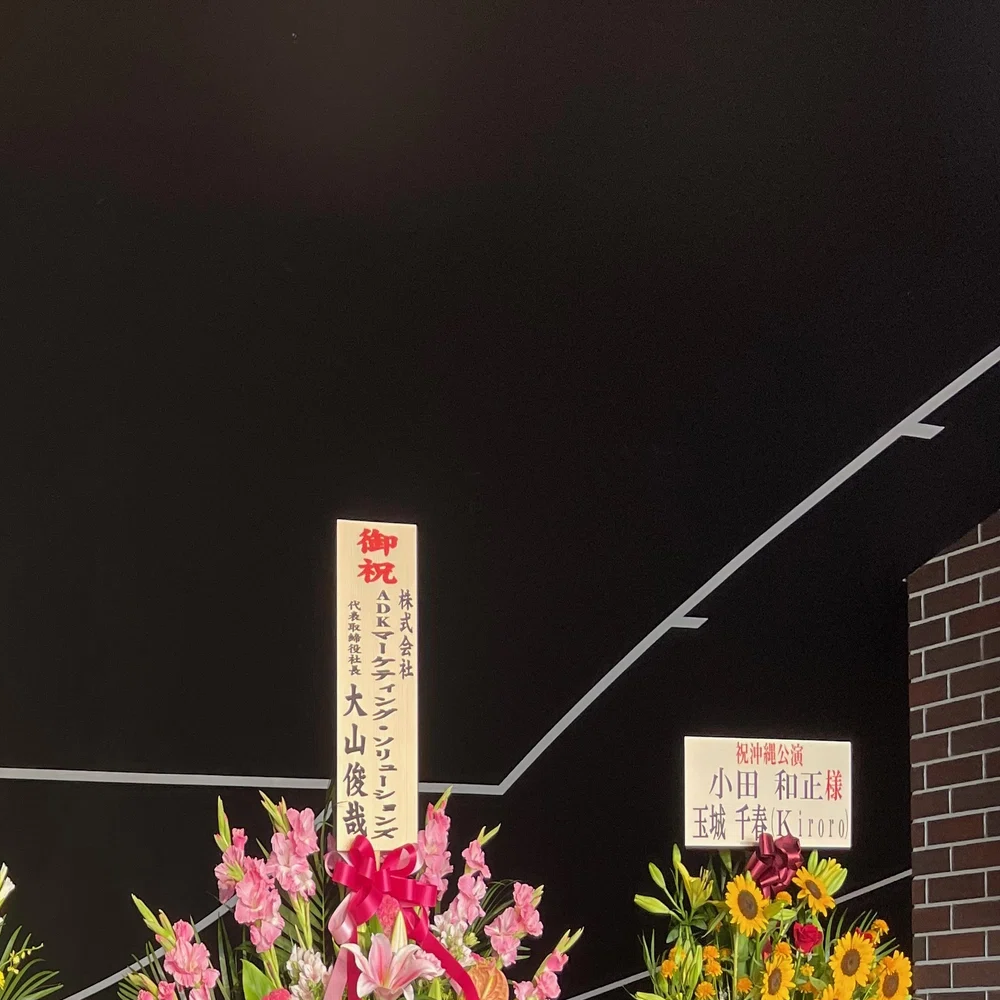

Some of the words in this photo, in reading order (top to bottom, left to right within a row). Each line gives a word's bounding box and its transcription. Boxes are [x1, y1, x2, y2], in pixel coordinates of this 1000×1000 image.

[356, 527, 398, 585] 御祝
[398, 588, 414, 680] 株式会社
[735, 741, 804, 767] 祝沖縄公演
